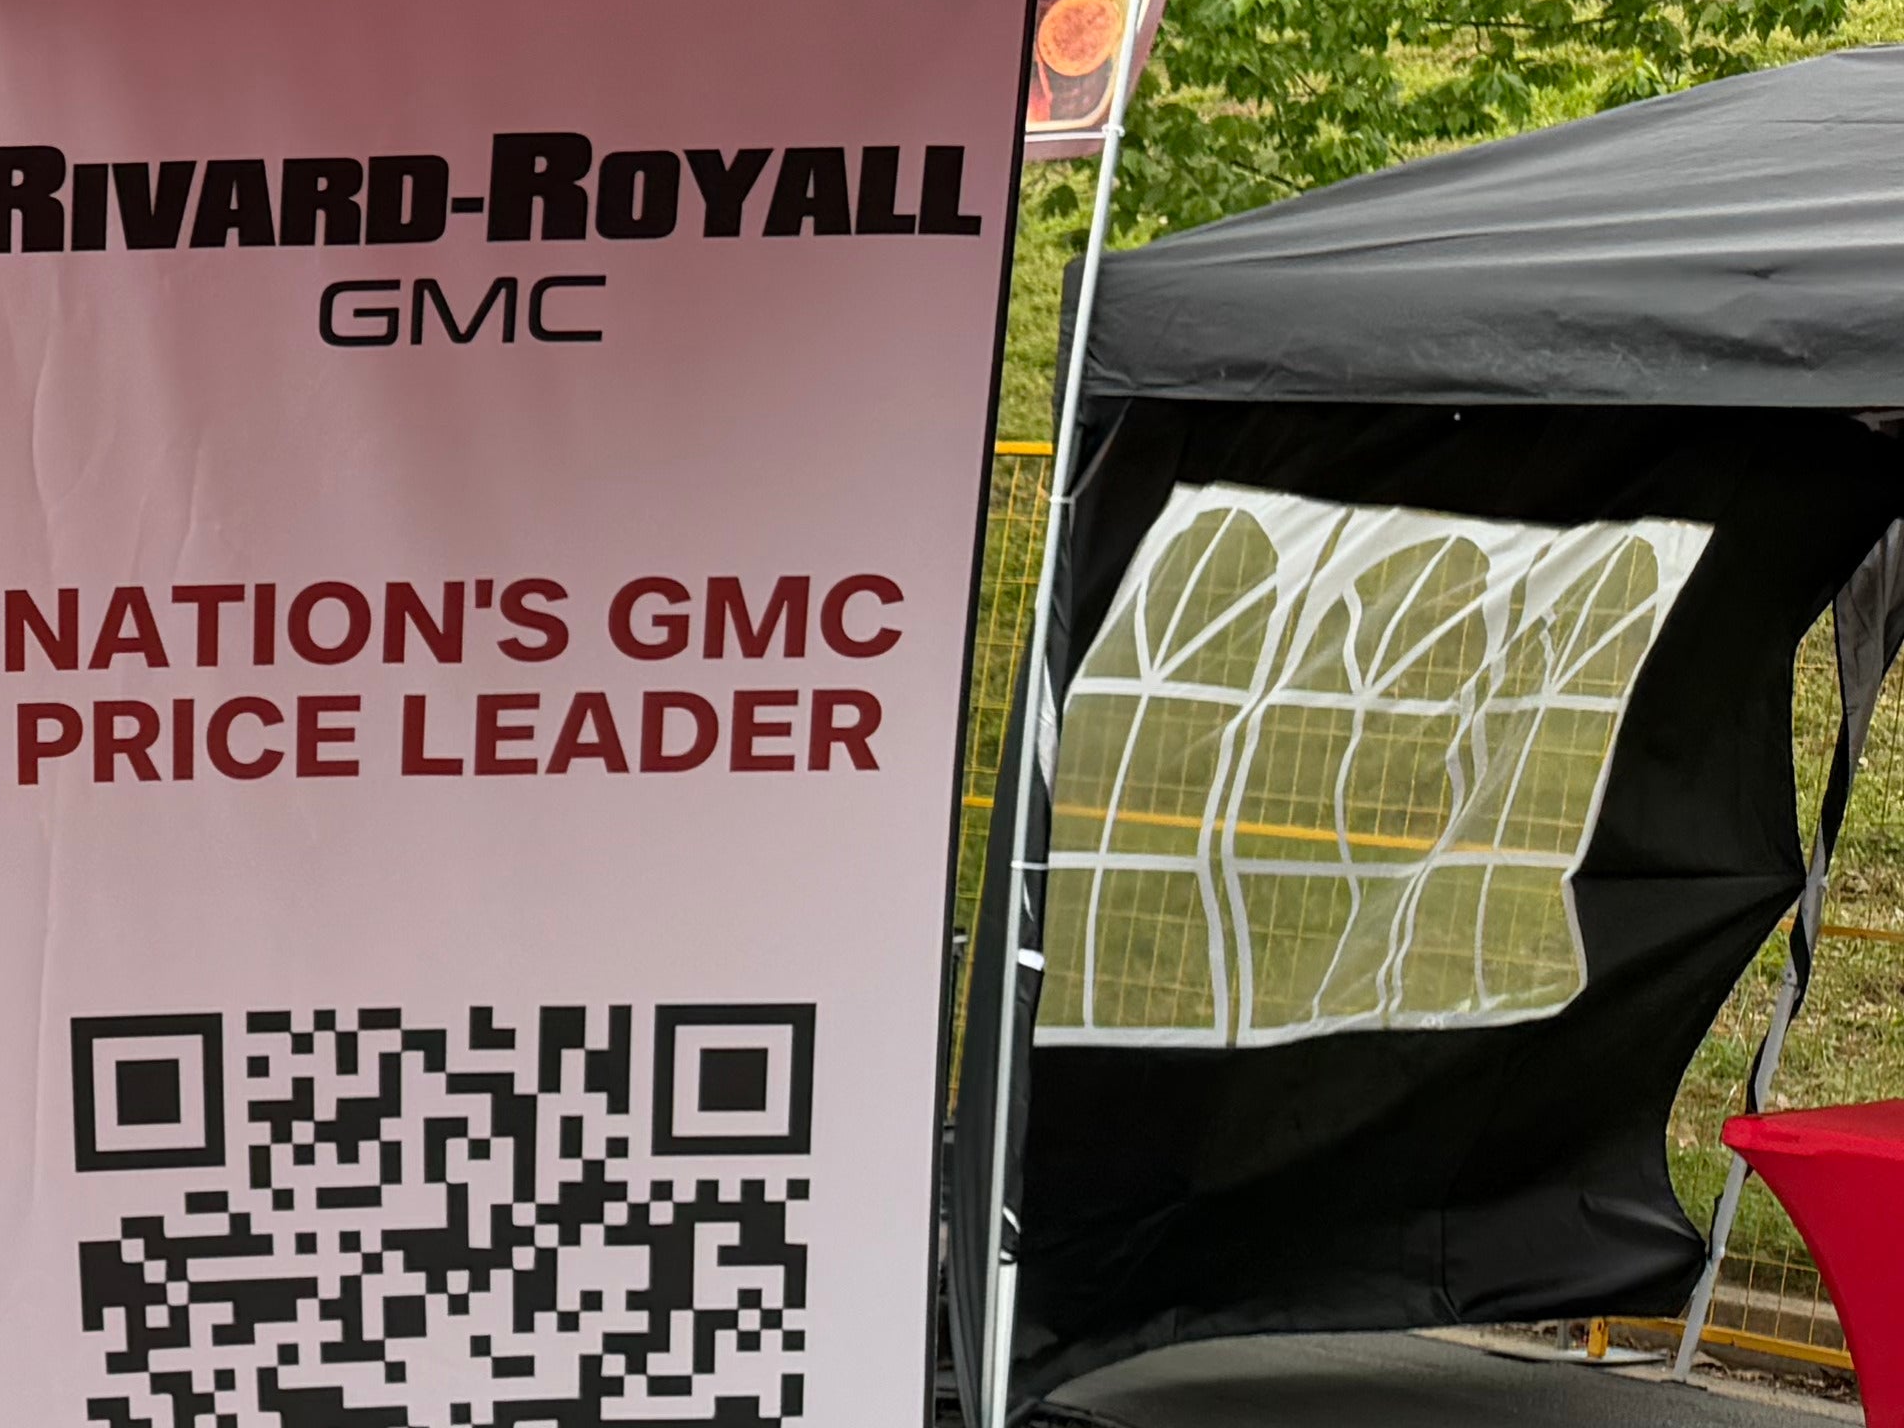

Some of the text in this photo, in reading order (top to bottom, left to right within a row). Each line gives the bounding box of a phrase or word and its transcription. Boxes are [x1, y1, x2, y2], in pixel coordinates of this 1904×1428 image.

[318, 274, 606, 347] GMC
[4, 574, 905, 673] NATION'S GMC
[17, 688, 884, 785] PRICE LEADER
